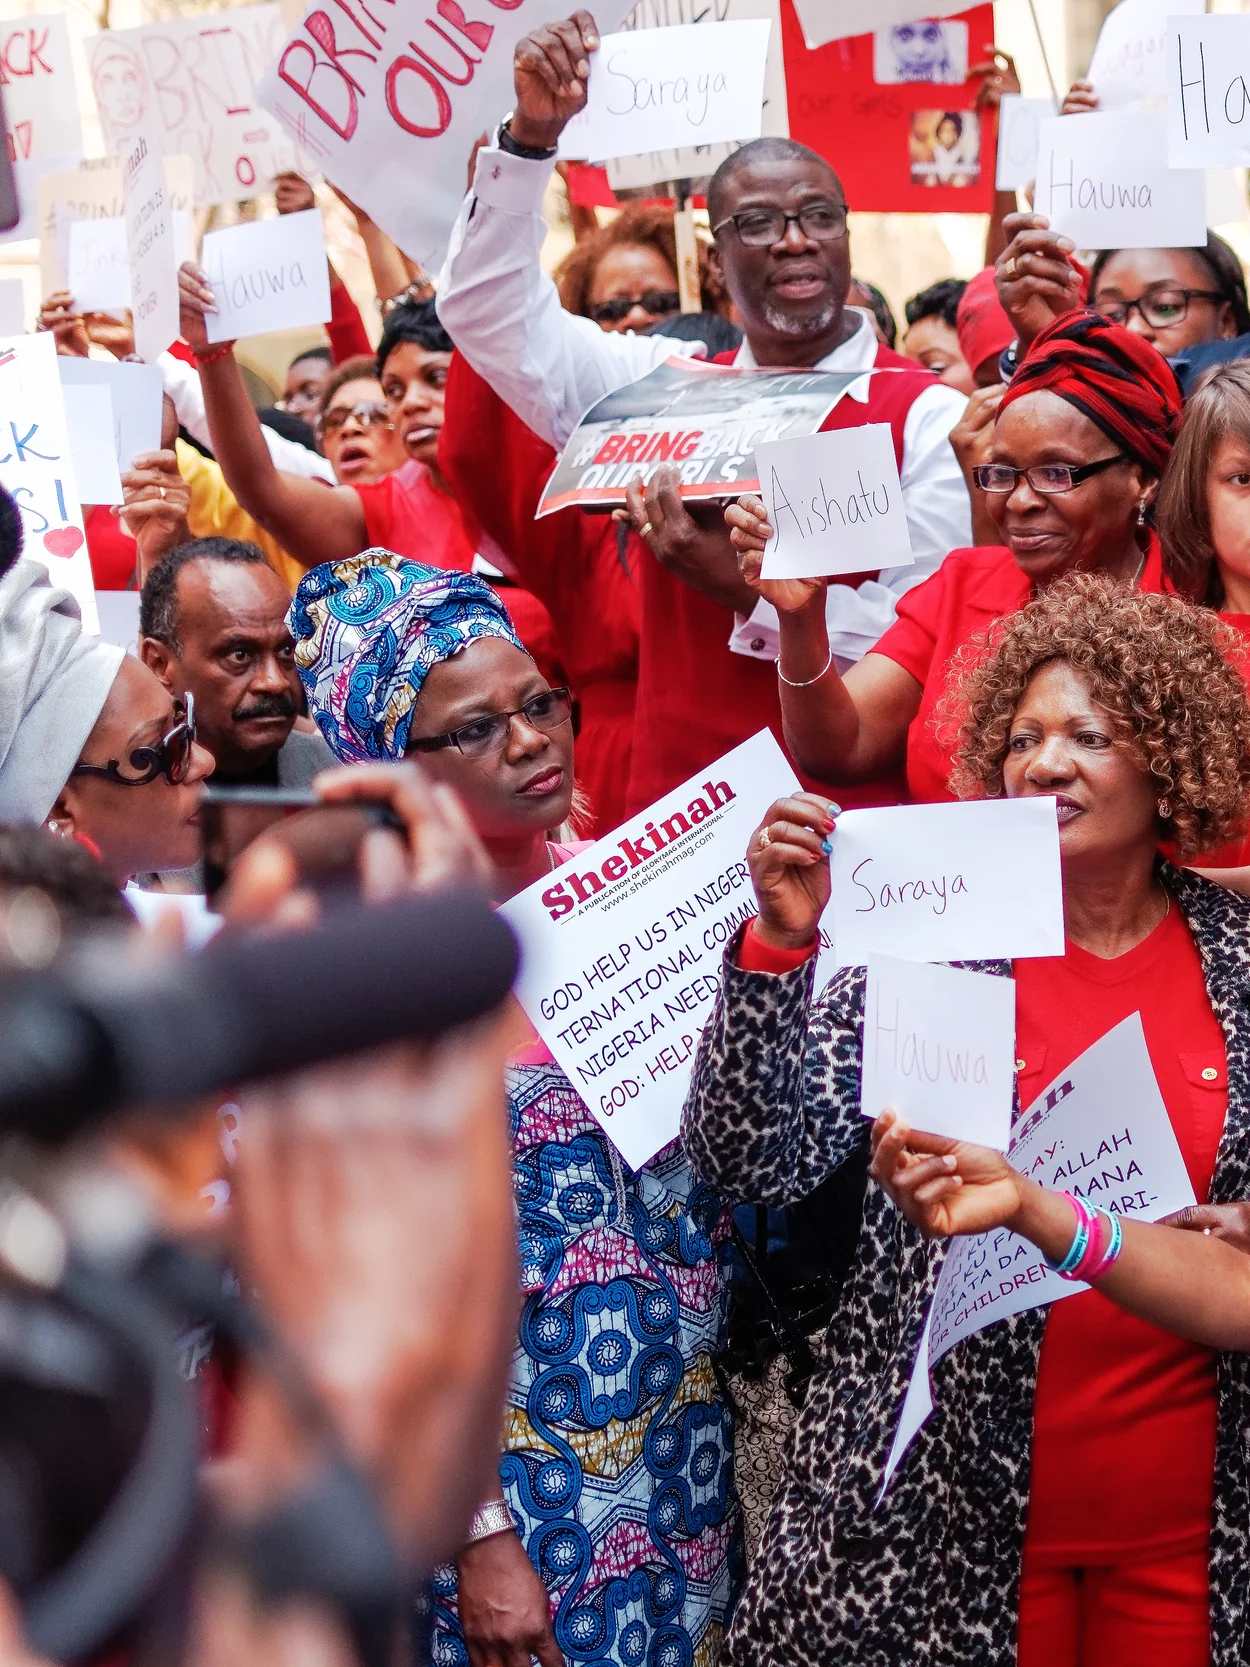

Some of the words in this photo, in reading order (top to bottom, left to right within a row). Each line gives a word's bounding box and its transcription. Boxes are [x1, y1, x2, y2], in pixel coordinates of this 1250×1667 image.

[606, 50, 727, 126] Saraya
[1048, 150, 1153, 216] Hauwa
[208, 248, 308, 317] Hauwa
[769, 464, 891, 553] Aishatu
[541, 781, 737, 921] Shekinah
[584, 877, 631, 911] PUBLICATION
[631, 870, 641, 880] OF
[641, 845, 678, 873] GLORYMAG
[677, 813, 724, 849] INTERNATIONAL
[600, 831, 715, 912] www.shekinahmag.com
[851, 857, 969, 915] Saraya
[540, 982, 583, 1020] GOD
[583, 943, 631, 989] HELP
[635, 921, 667, 951] US
[666, 900, 697, 932] IN
[693, 857, 750, 912] NIGER
[556, 944, 703, 1049] TERNATIONAL
[874, 980, 989, 1087] Hauwa
[576, 1012, 665, 1085] NIGERIA
[600, 1075, 645, 1117] GOD:
[646, 1034, 694, 1082] HELP
[1053, 1127, 1133, 1185] ALLAH
[963, 1250, 987, 1283] KU
[998, 1244, 1028, 1270] DA
